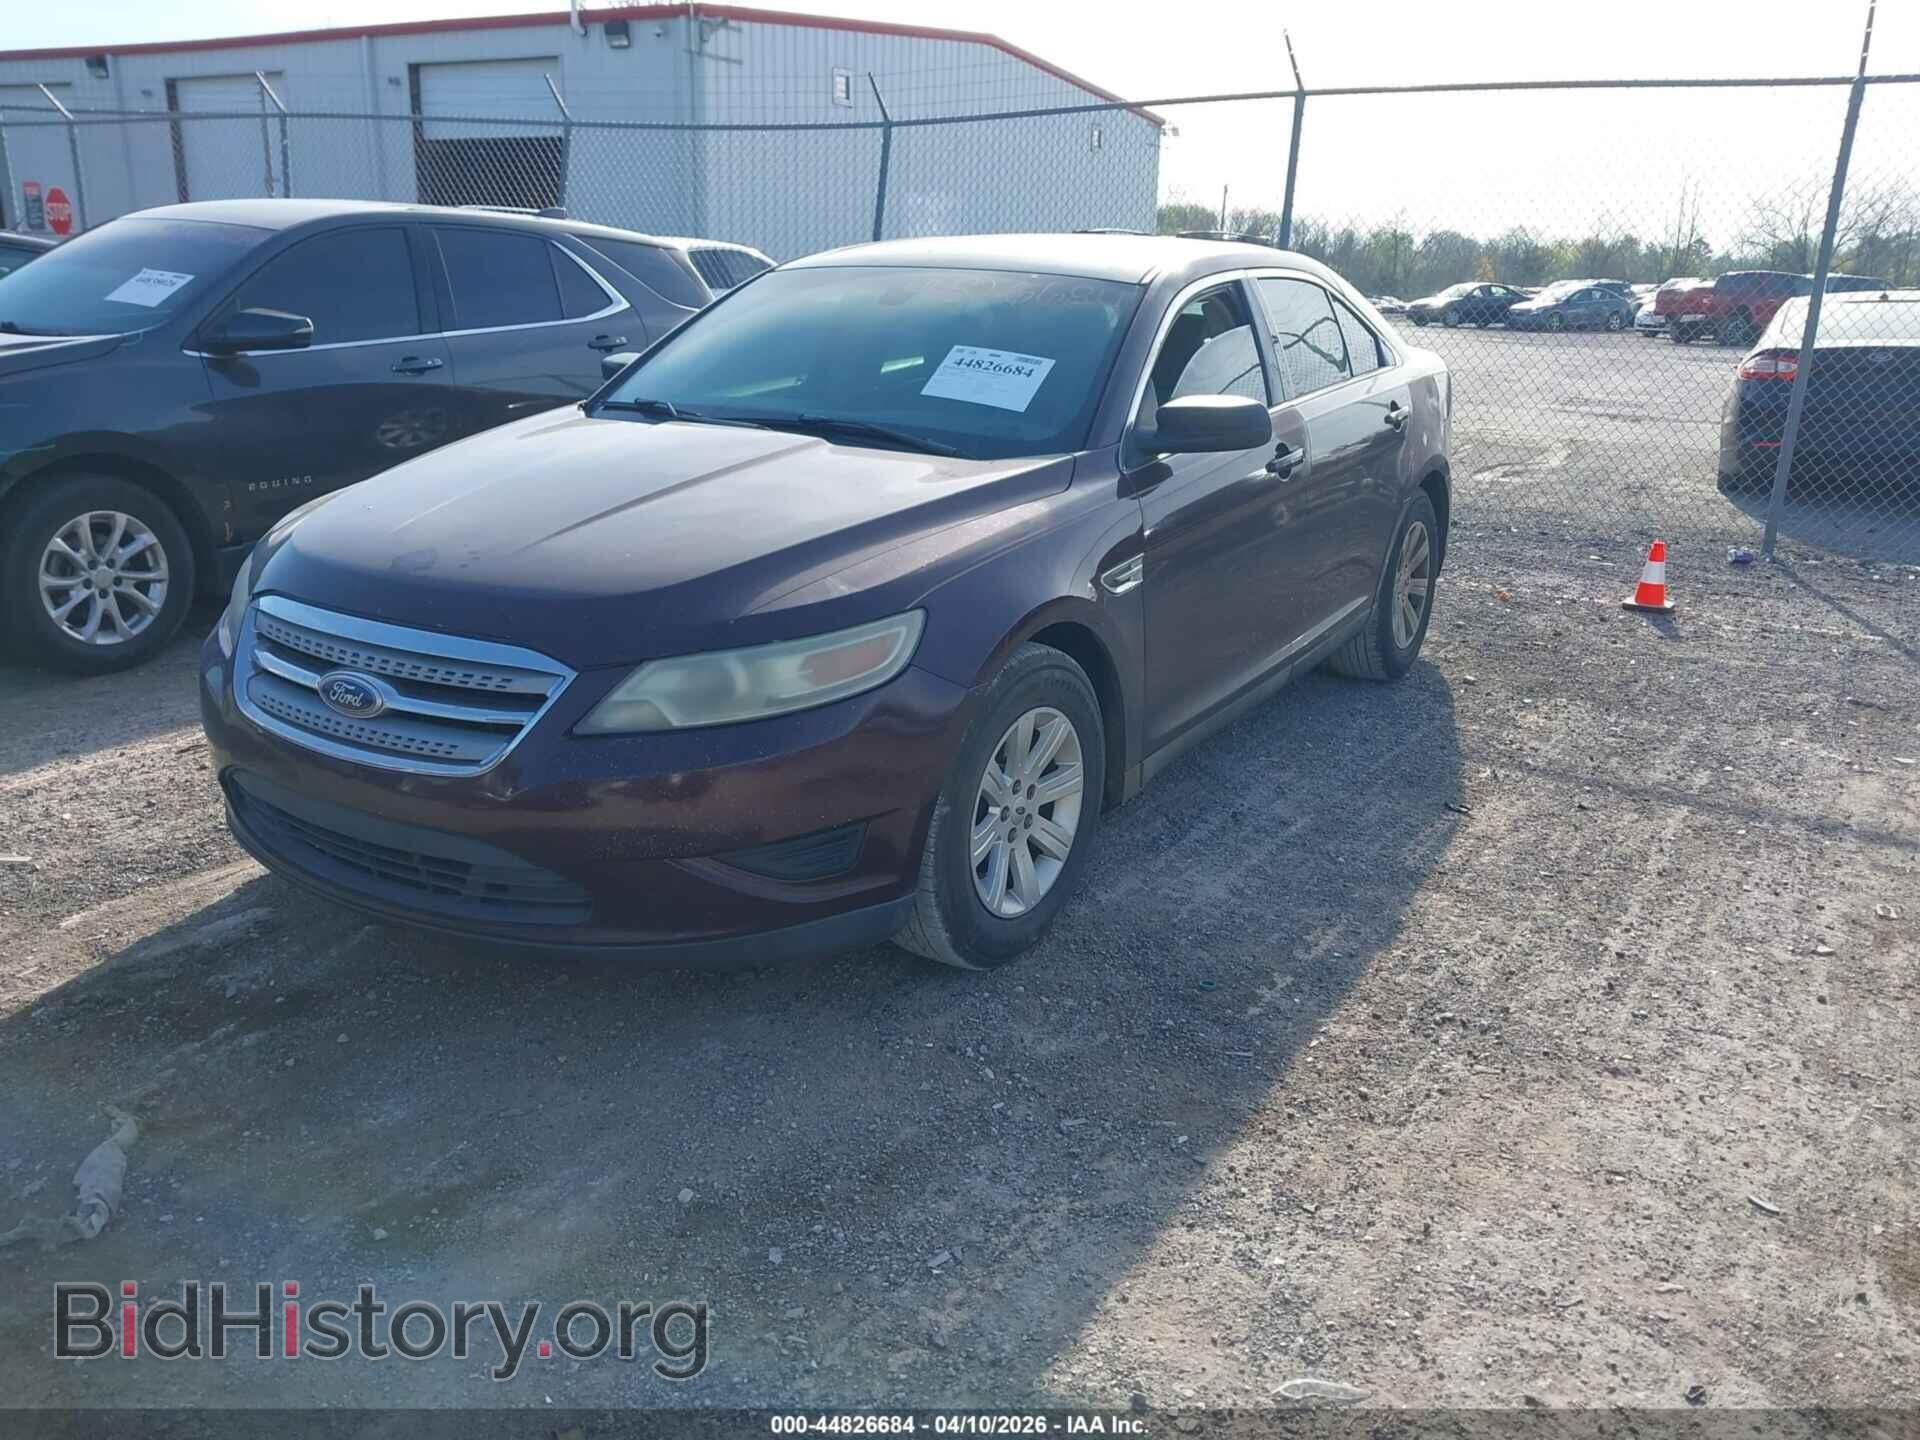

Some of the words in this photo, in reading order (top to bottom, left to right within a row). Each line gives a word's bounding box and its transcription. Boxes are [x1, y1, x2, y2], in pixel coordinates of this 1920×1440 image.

[47, 203, 72, 222] STOP
[954, 357, 1034, 378] 44826684
[329, 681, 364, 707] Ford
